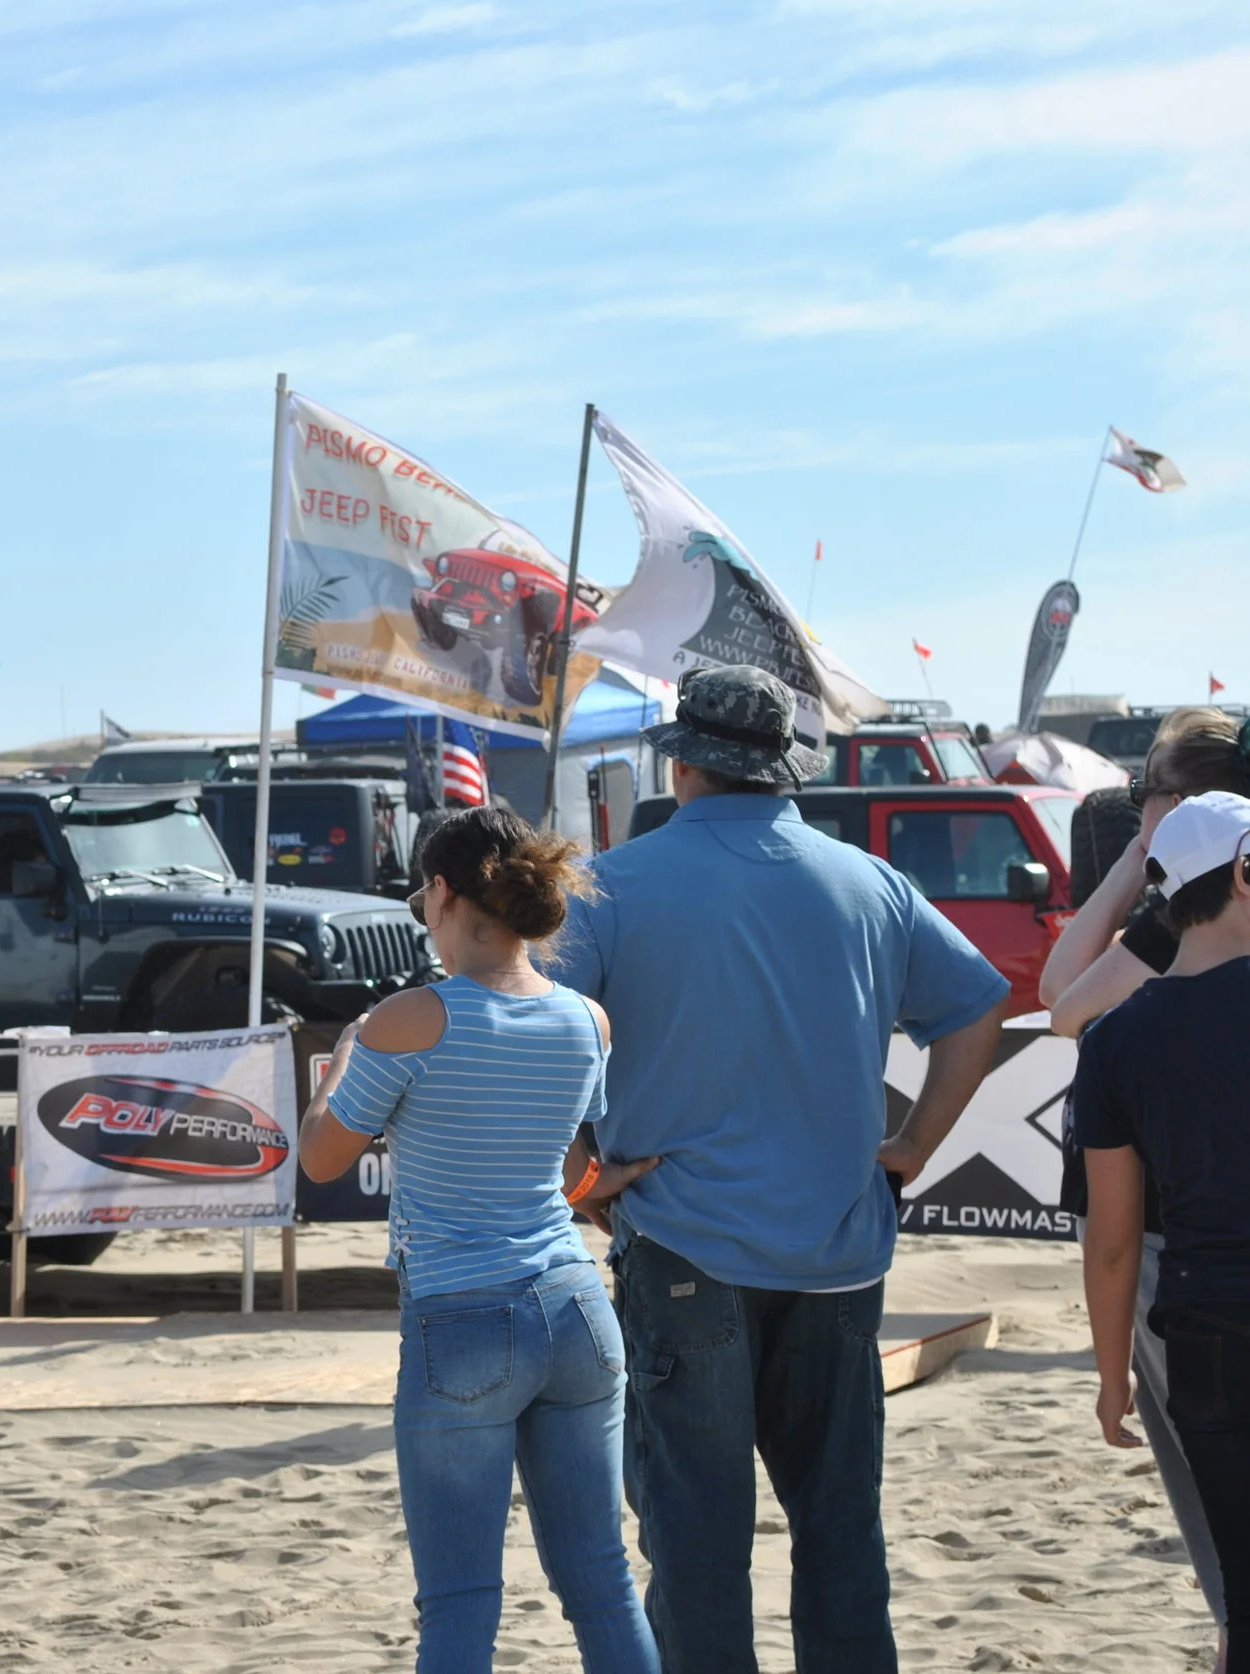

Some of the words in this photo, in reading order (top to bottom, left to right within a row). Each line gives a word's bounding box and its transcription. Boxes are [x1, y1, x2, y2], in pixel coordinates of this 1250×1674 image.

[304, 423, 388, 468] PISMO
[300, 487, 371, 525] JEEP
[672, 650, 687, 666] A
[168, 1038, 218, 1053] PARTS
[58, 1092, 177, 1137] POLY
[169, 1113, 290, 1149] PERFORMANCE
[922, 1204, 1078, 1233] FLOWMAS
